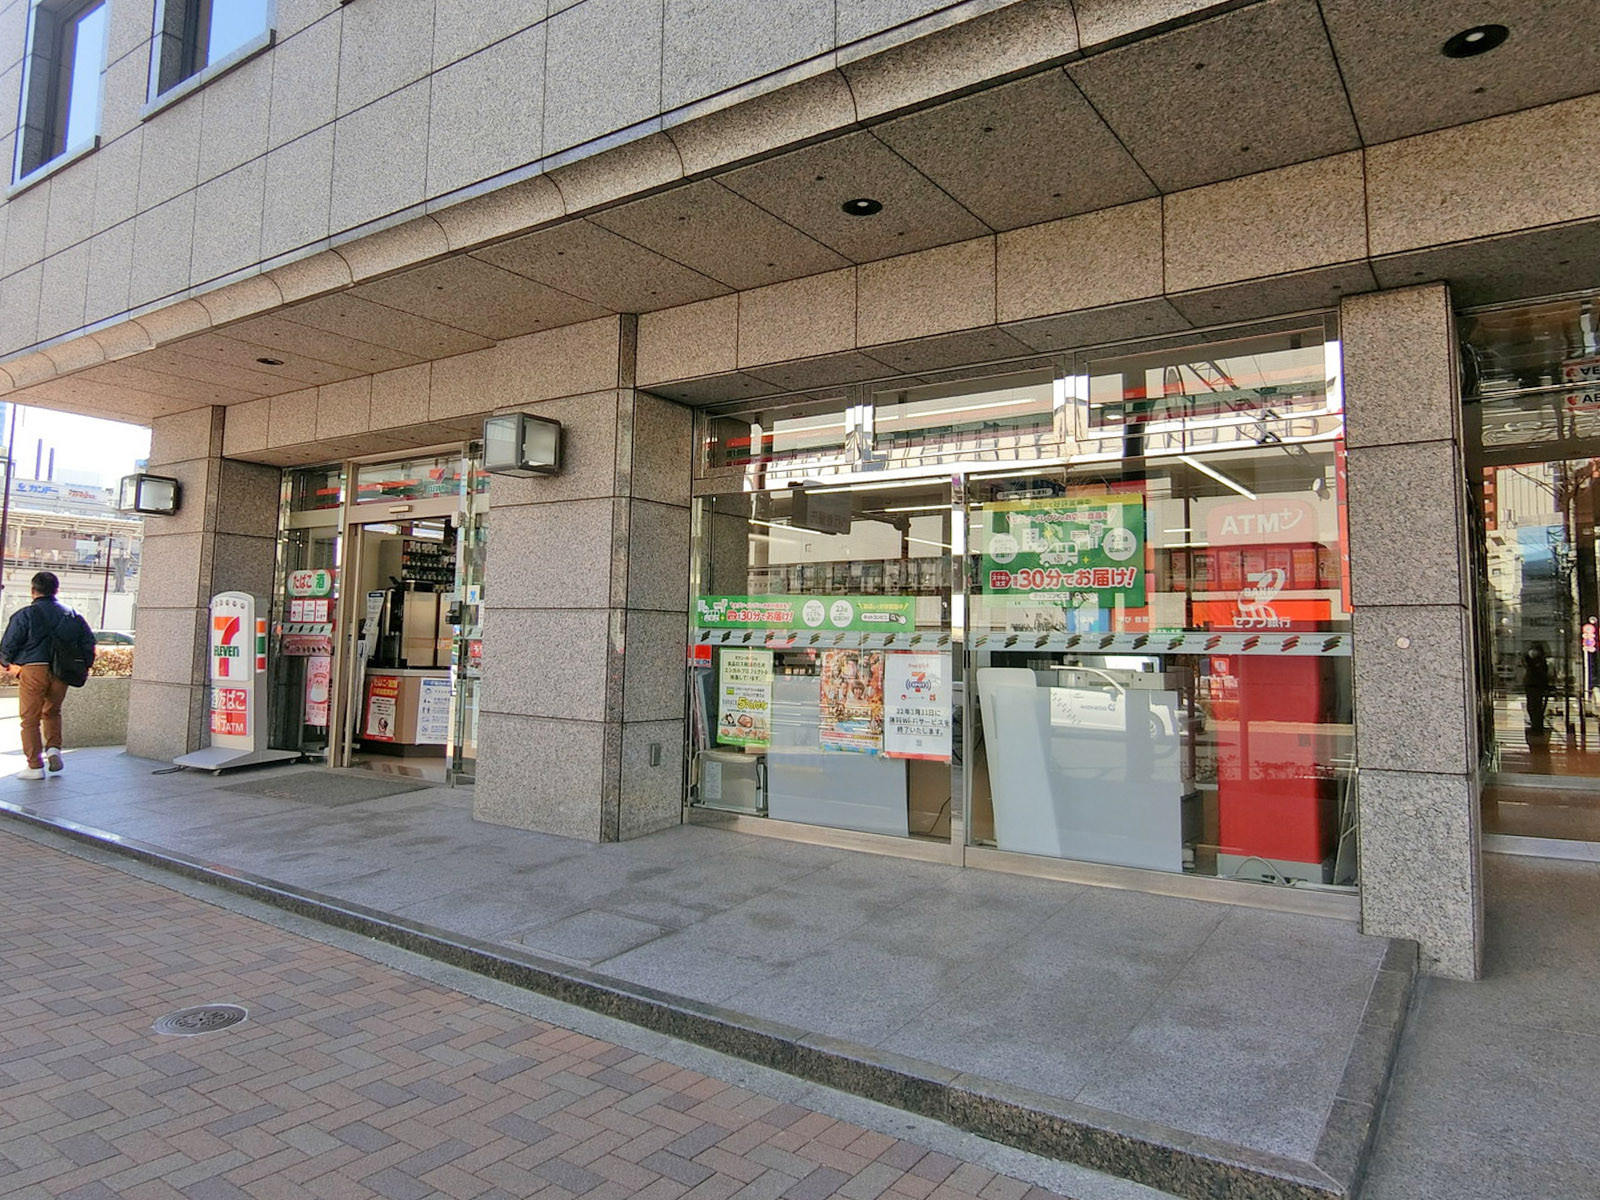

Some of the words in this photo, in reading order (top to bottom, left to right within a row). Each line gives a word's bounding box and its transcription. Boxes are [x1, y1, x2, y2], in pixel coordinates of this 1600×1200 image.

[292, 573, 312, 589] たばこ
[316, 573, 325, 589] 酒
[1019, 568, 1136, 588] 30分でお届け!
